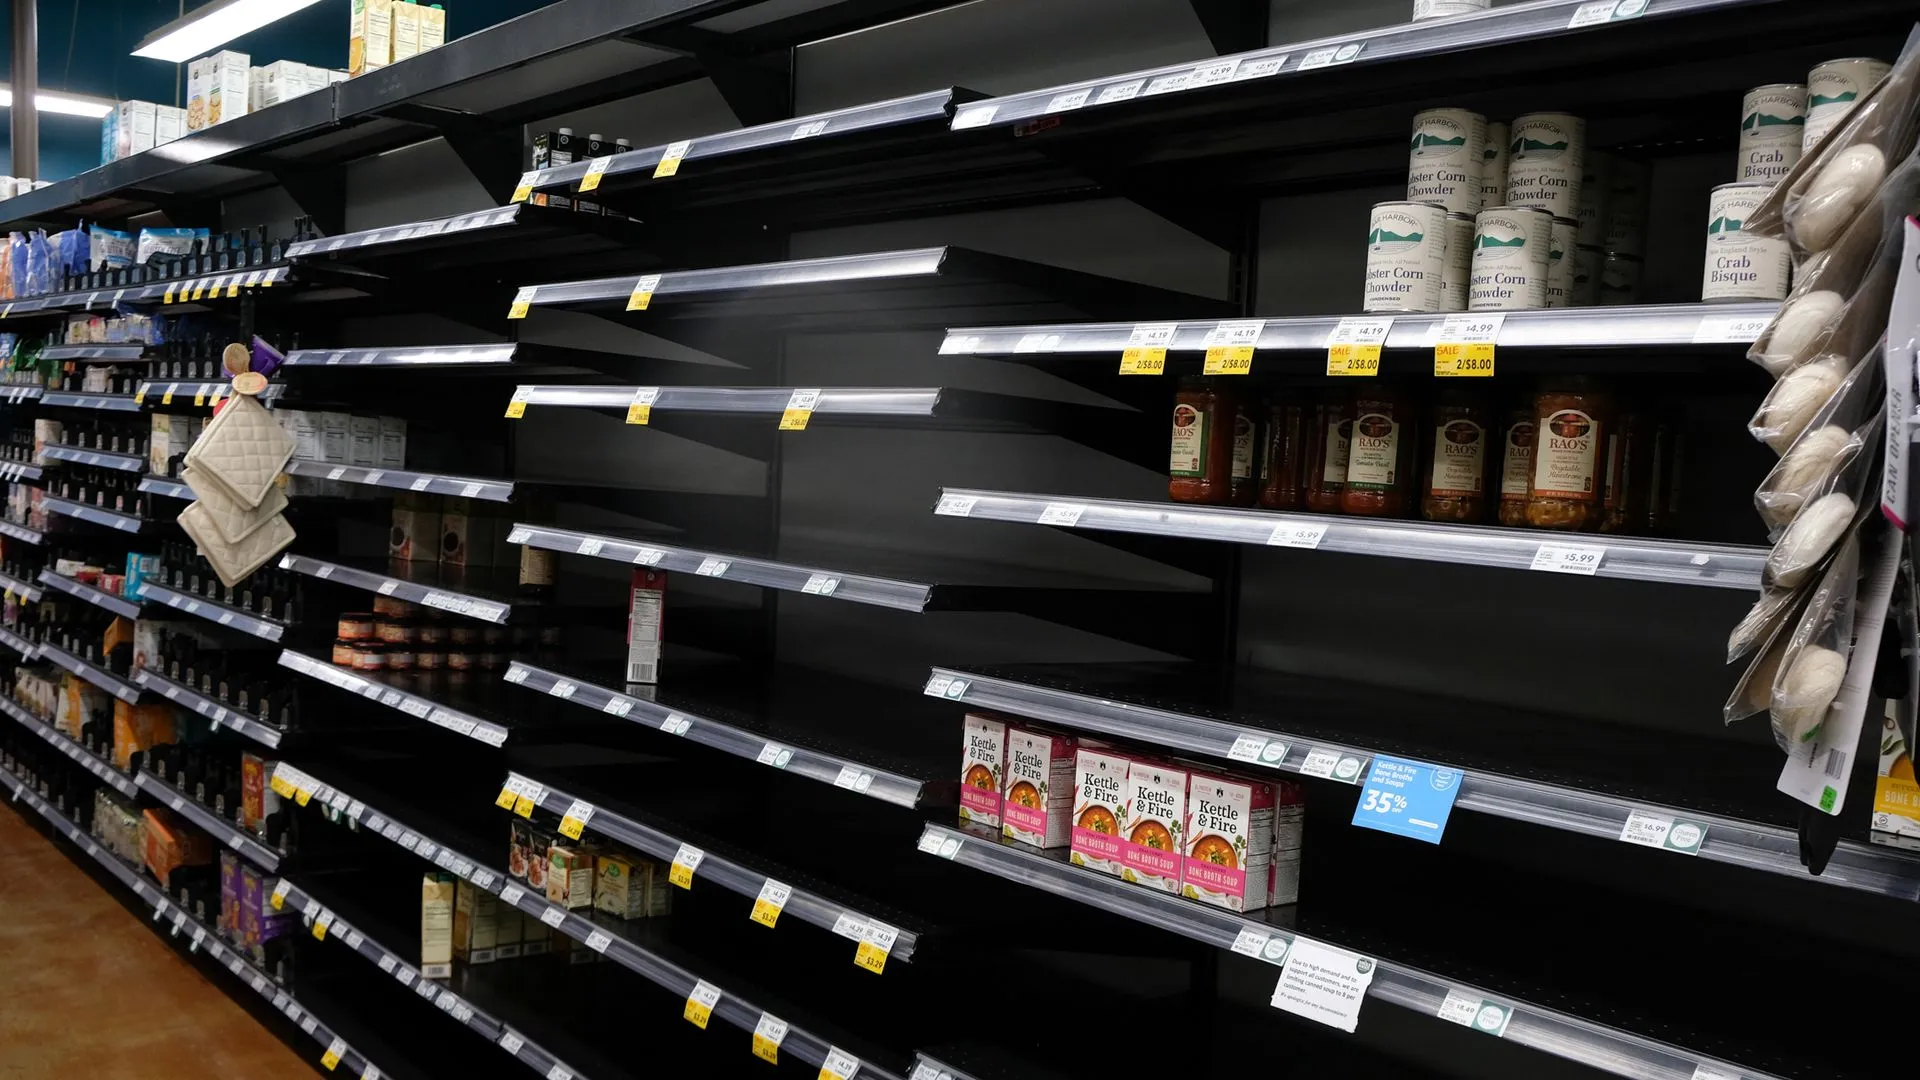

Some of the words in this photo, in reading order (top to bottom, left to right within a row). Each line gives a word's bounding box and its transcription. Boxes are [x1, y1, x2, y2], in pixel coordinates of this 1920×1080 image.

[1760, 96, 1801, 110] HARBOR
[1425, 118, 1459, 132] HARBOR
[1525, 122, 1563, 136] HARBOR
[1750, 150, 1784, 164] Crab
[1437, 170, 1466, 182] Corn
[1744, 165, 1790, 179] Bisque
[1538, 175, 1568, 187] Corn
[1409, 184, 1455, 197] Chowder
[1508, 188, 1558, 202] Chowder
[1382, 212, 1417, 228] HARBOR
[1485, 218, 1519, 232] HARBOR
[1717, 255, 1751, 270] Crab
[1393, 267, 1424, 281] Corn
[1494, 273, 1526, 285] Corn
[1711, 270, 1758, 286] Bisque
[1234, 329, 1256, 338] $4.19
[1359, 327, 1384, 336] $4.19
[1467, 324, 1494, 334] $4.99
[1731, 322, 1764, 332] $4.99
[1148, 331, 1169, 340] $4.19
[1436, 346, 1460, 356] SALE
[1136, 359, 1163, 370] 2/$8.00
[1222, 359, 1250, 369] 2/$8.00
[1347, 359, 1378, 370] 2/$8.00
[1456, 359, 1492, 370] 2/$8.00
[1888, 387, 1904, 461] OPENER
[1358, 437, 1390, 449] RAO'S
[1445, 444, 1477, 456] RAO'S
[1549, 437, 1588, 451] RAO'S
[1885, 463, 1899, 505] CAN
[1295, 530, 1319, 539] $5.99
[1564, 553, 1595, 563] $5.99
[970, 735, 997, 752] Kettle
[969, 747, 976, 758] &
[977, 747, 996, 763] Fire
[1015, 750, 1043, 768] Kettle
[1013, 763, 1021, 774] &
[1021, 765, 1042, 780] Fire
[1378, 760, 1397, 770] Kettle
[1396, 763, 1404, 771] &
[1403, 765, 1418, 775] Fire
[1084, 773, 1120, 791] Kettle
[1372, 776, 1384, 784] and
[1375, 768, 1391, 777] Bone
[1391, 771, 1413, 782] Broths
[1083, 786, 1093, 798] &
[1094, 788, 1119, 805] Fire
[1137, 786, 1175, 806] Kettle
[1884, 790, 1908, 802] BONE
[1136, 799, 1146, 812] &
[1147, 802, 1173, 819] Fire
[1199, 800, 1239, 821] Kettle
[1006, 809, 1016, 818] BONE
[1016, 811, 1030, 822] BROTH
[1030, 814, 1042, 826] SOUP
[1198, 813, 1208, 827] &
[1209, 815, 1237, 834] Fire
[1644, 823, 1666, 833] $6.99
[1075, 834, 1087, 845] BONE
[1088, 836, 1105, 849] BROTH
[1105, 841, 1119, 853] SOUP
[1127, 850, 1139, 860] BONE
[1141, 852, 1159, 866] BROTH
[1159, 857, 1174, 870] SOUP
[1188, 866, 1203, 877] BONE
[1203, 869, 1221, 882] BROTH
[1222, 874, 1239, 887] SOUP
[866, 956, 884, 969] $3.29
[1292, 958, 1302, 966] Due
[1309, 963, 1320, 973] high
[1319, 967, 1341, 978] demand
[1340, 972, 1351, 981] and
[1350, 976, 1357, 984] to
[1289, 967, 1309, 979] support
[1350, 985, 1360, 993] are
[1286, 974, 1305, 985] limiting
[1304, 979, 1323, 990] canned
[1323, 985, 1336, 995] soup
[1336, 989, 1342, 997] to
[1346, 994, 1356, 1003] per
